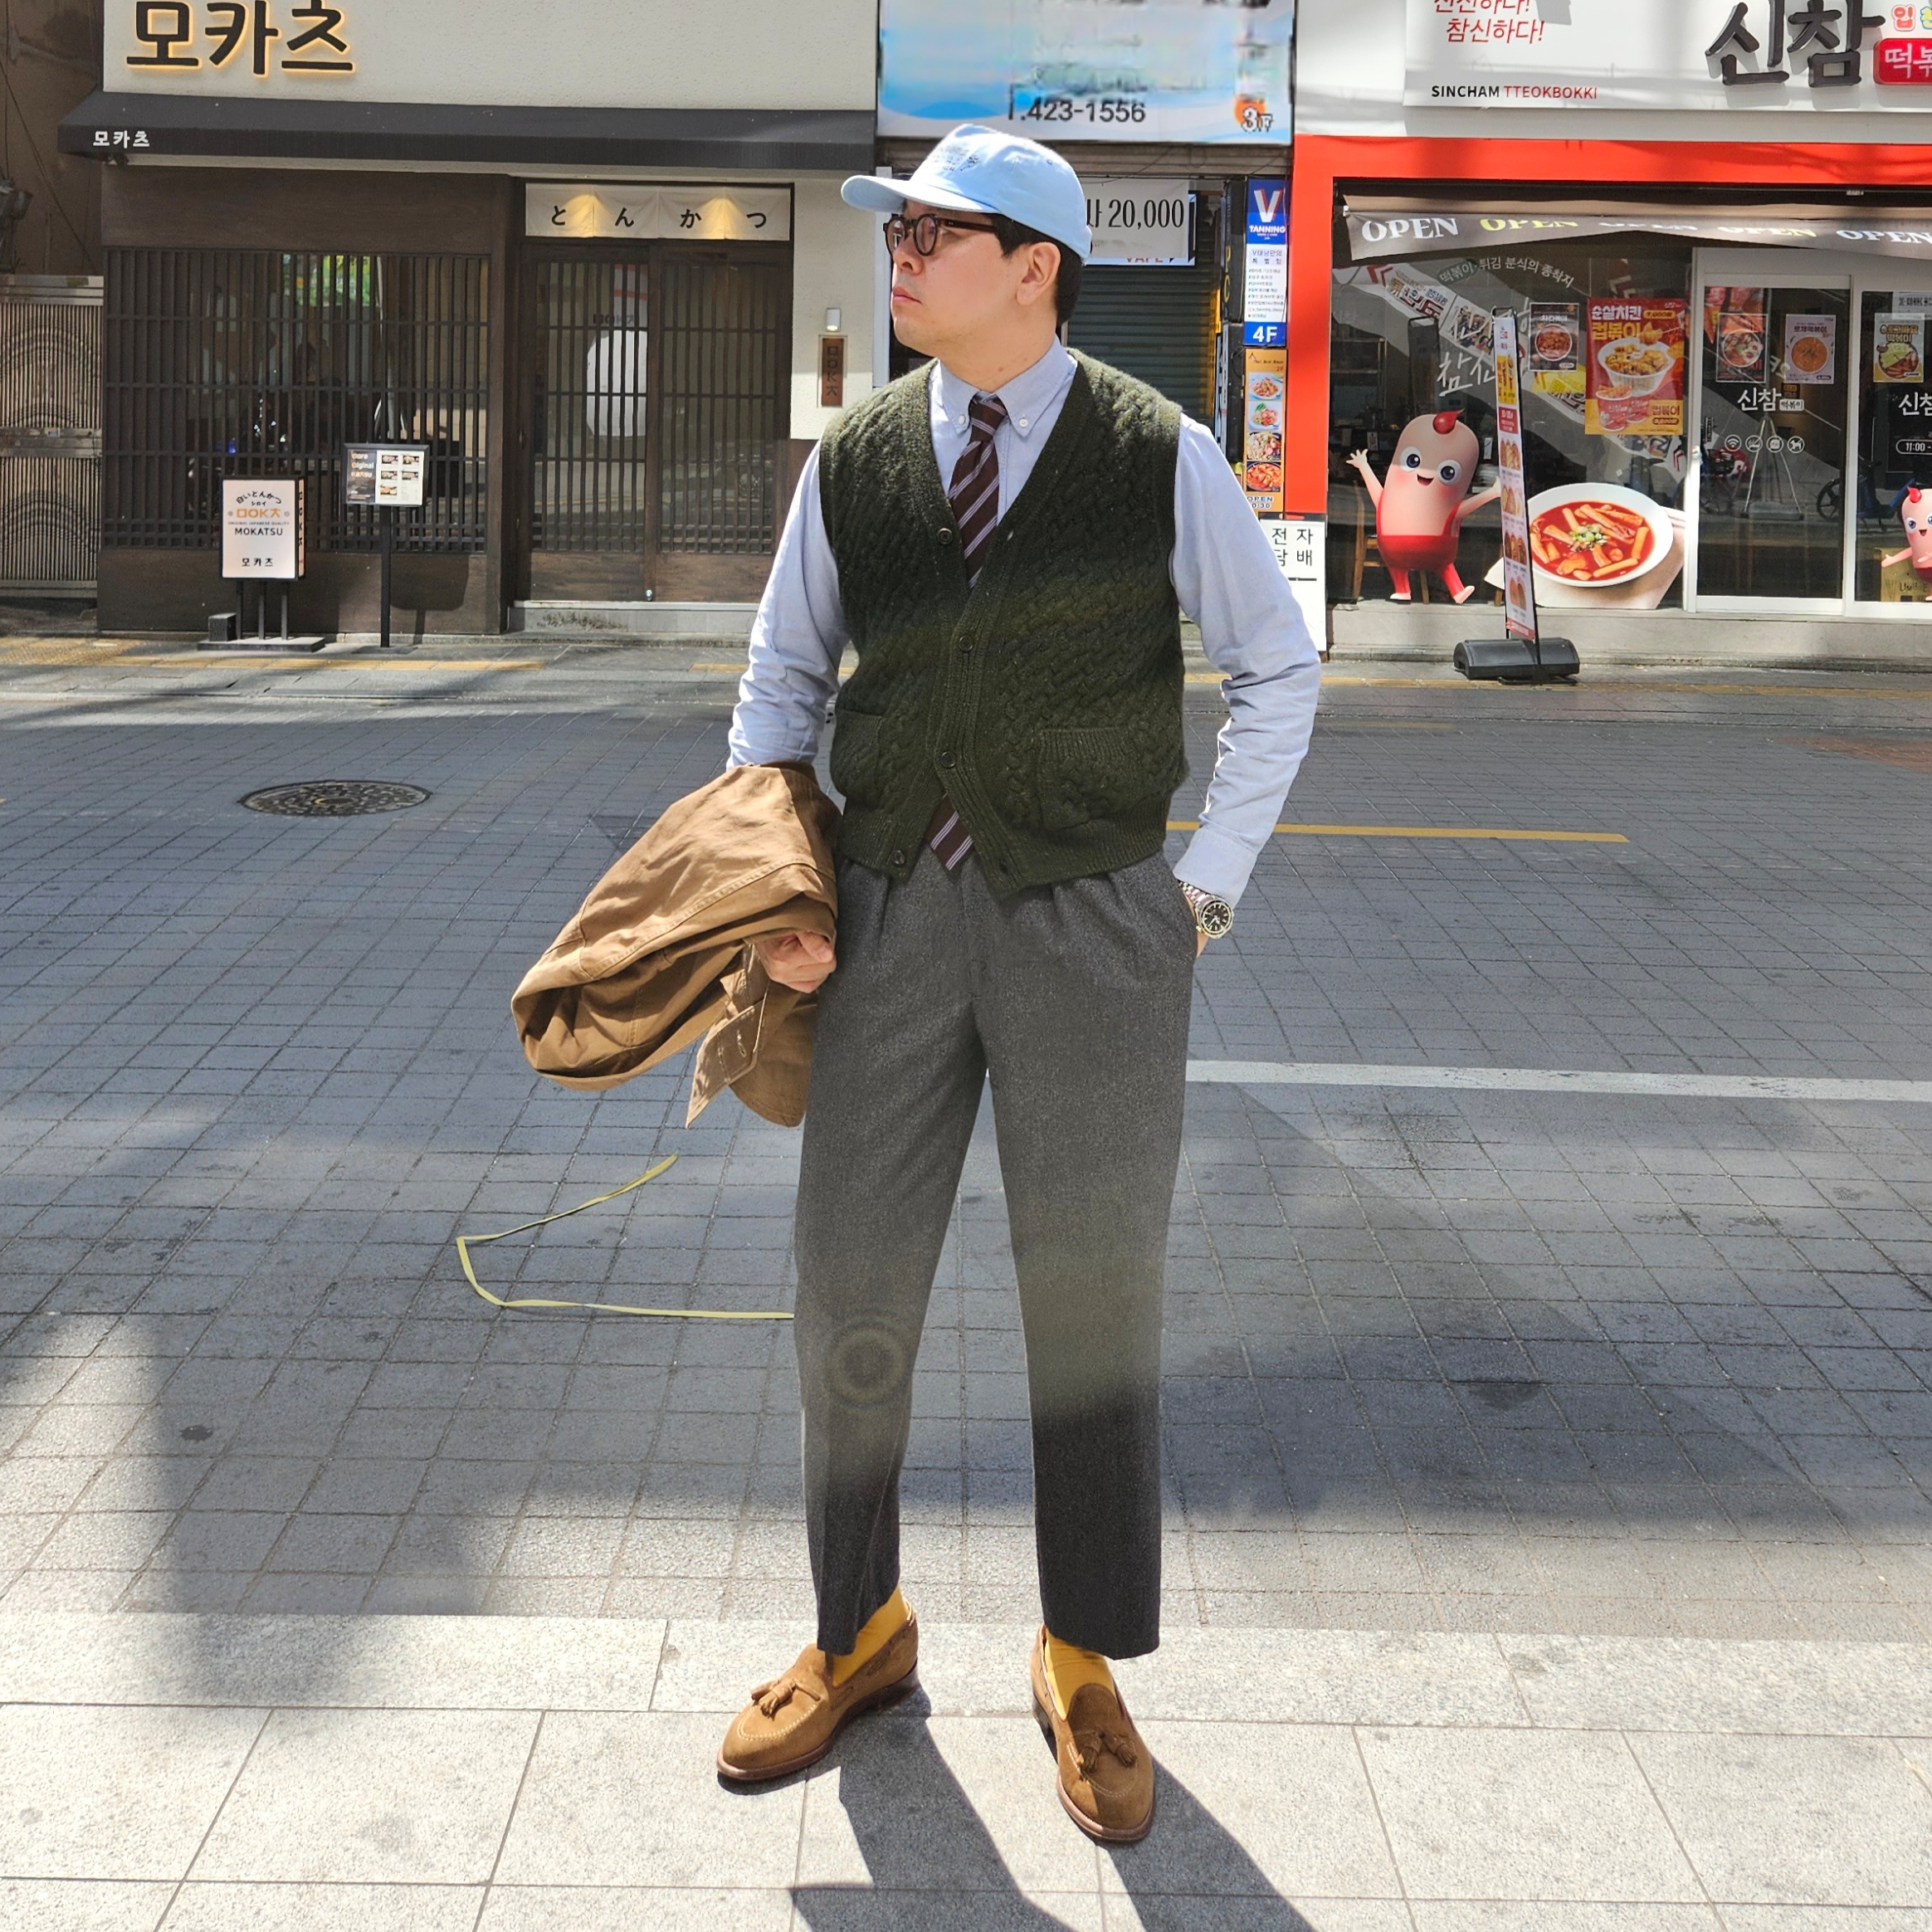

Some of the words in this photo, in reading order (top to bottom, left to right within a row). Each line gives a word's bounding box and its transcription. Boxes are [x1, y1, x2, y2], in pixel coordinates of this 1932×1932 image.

[126, 0, 354, 76] 모카츠
[1447, 18, 1545, 44] 참신하다!
[1705, 0, 1886, 87] 신참
[1432, 85, 1500, 98] SINCHAM
[1504, 85, 1598, 100] TTEOKBOKKI
[93, 130, 150, 149] 모카츠
[1108, 199, 1184, 230] 20,000
[1254, 188, 1283, 222] V
[550, 206, 768, 229] とんかつ
[1249, 225, 1286, 233] TANNING
[1362, 217, 1459, 242] OPEN
[1837, 229, 1932, 244] OPEN
[1480, 256, 1501, 271] 튀김
[1505, 256, 1539, 273] 분식의
[1541, 264, 1574, 288] 종착지
[1592, 305, 1642, 320] 순살치킨
[1252, 325, 1278, 343] 4F
[1737, 388, 1782, 412] 신참
[1905, 442, 1925, 452] 11:00
[235, 528, 283, 536] MOKATSU
[1271, 527, 1314, 545] 전자
[242, 557, 274, 567] 모카츠
